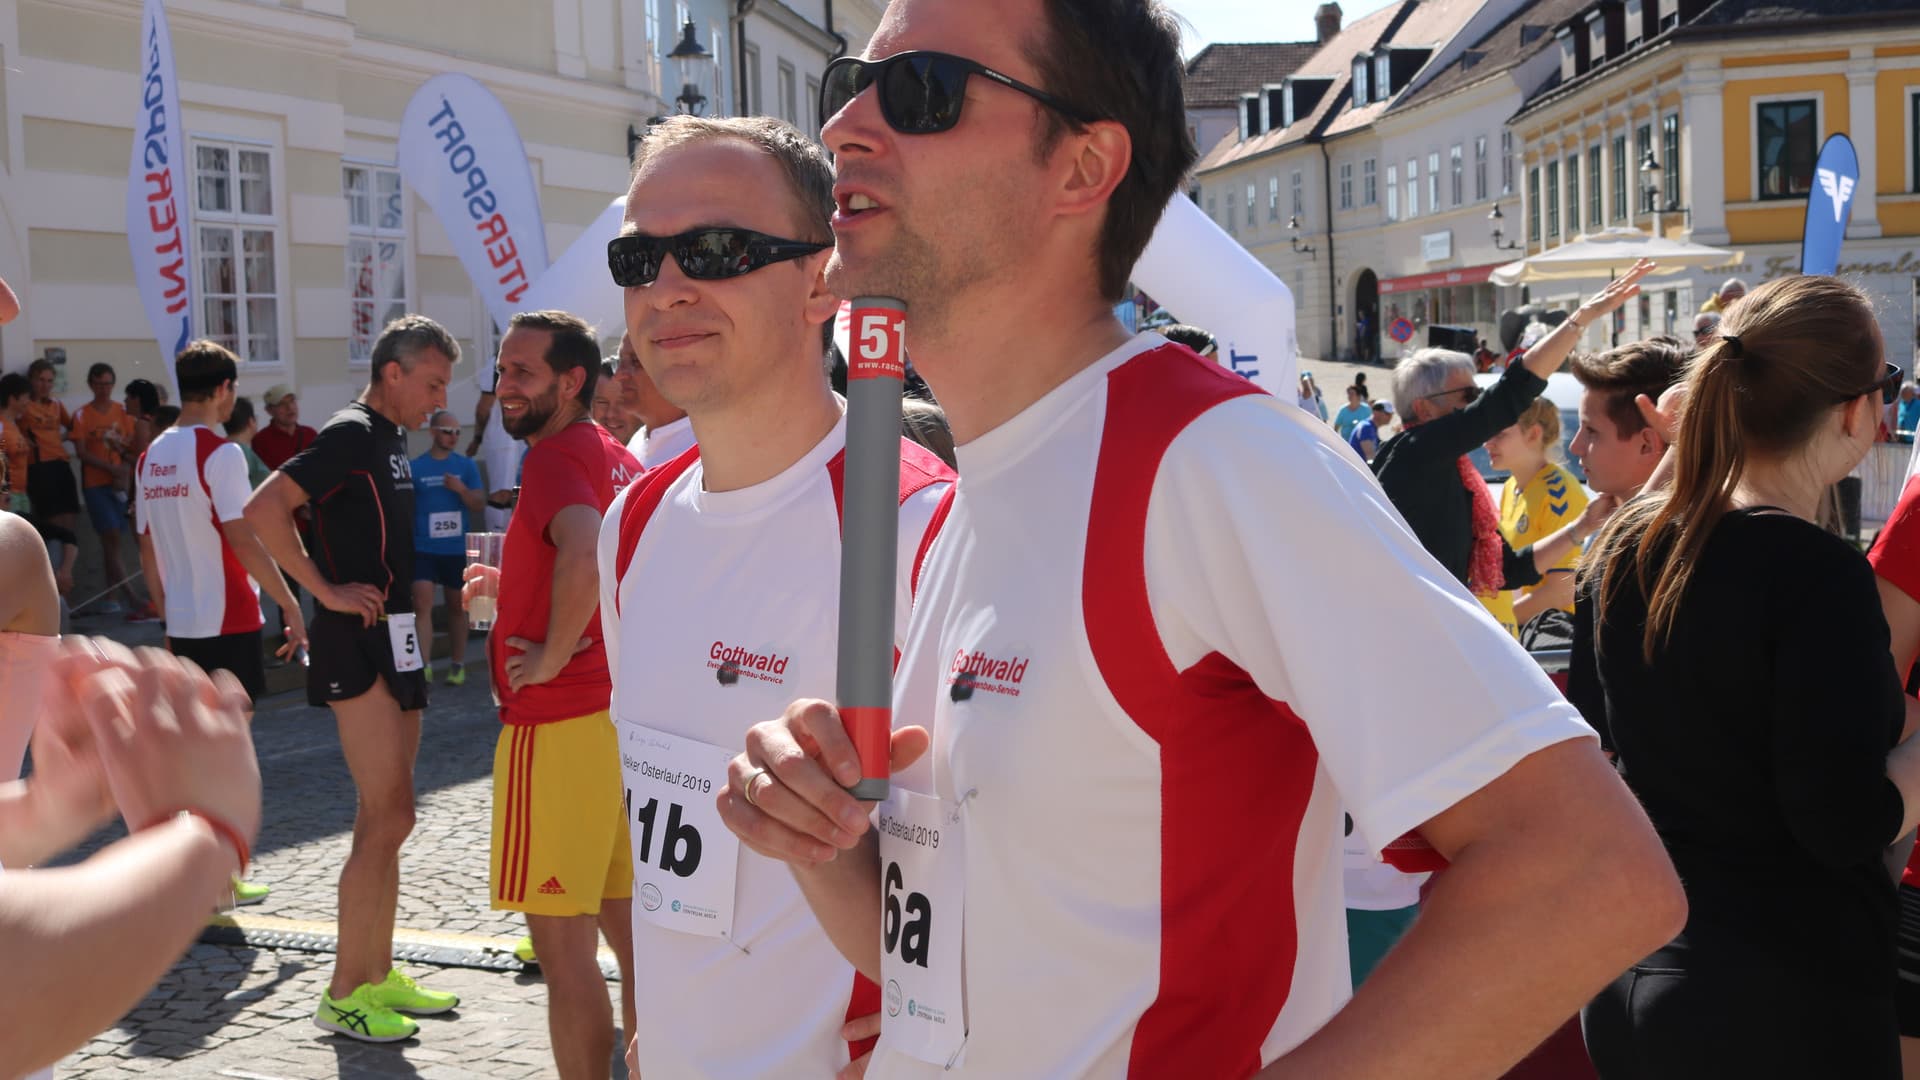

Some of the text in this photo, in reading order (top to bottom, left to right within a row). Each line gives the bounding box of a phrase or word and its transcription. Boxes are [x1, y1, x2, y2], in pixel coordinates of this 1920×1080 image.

[859, 315, 905, 363] 51
[150, 463, 177, 477] Team
[434, 520, 458, 531] 25b
[405, 633, 415, 655] 5
[710, 641, 790, 675] Gottwald
[951, 648, 1030, 684] Gottwald
[641, 761, 682, 785] Osterlauf
[682, 774, 711, 794] 2019
[888, 816, 916, 843] Osterlauf
[916, 826, 939, 849] 2019
